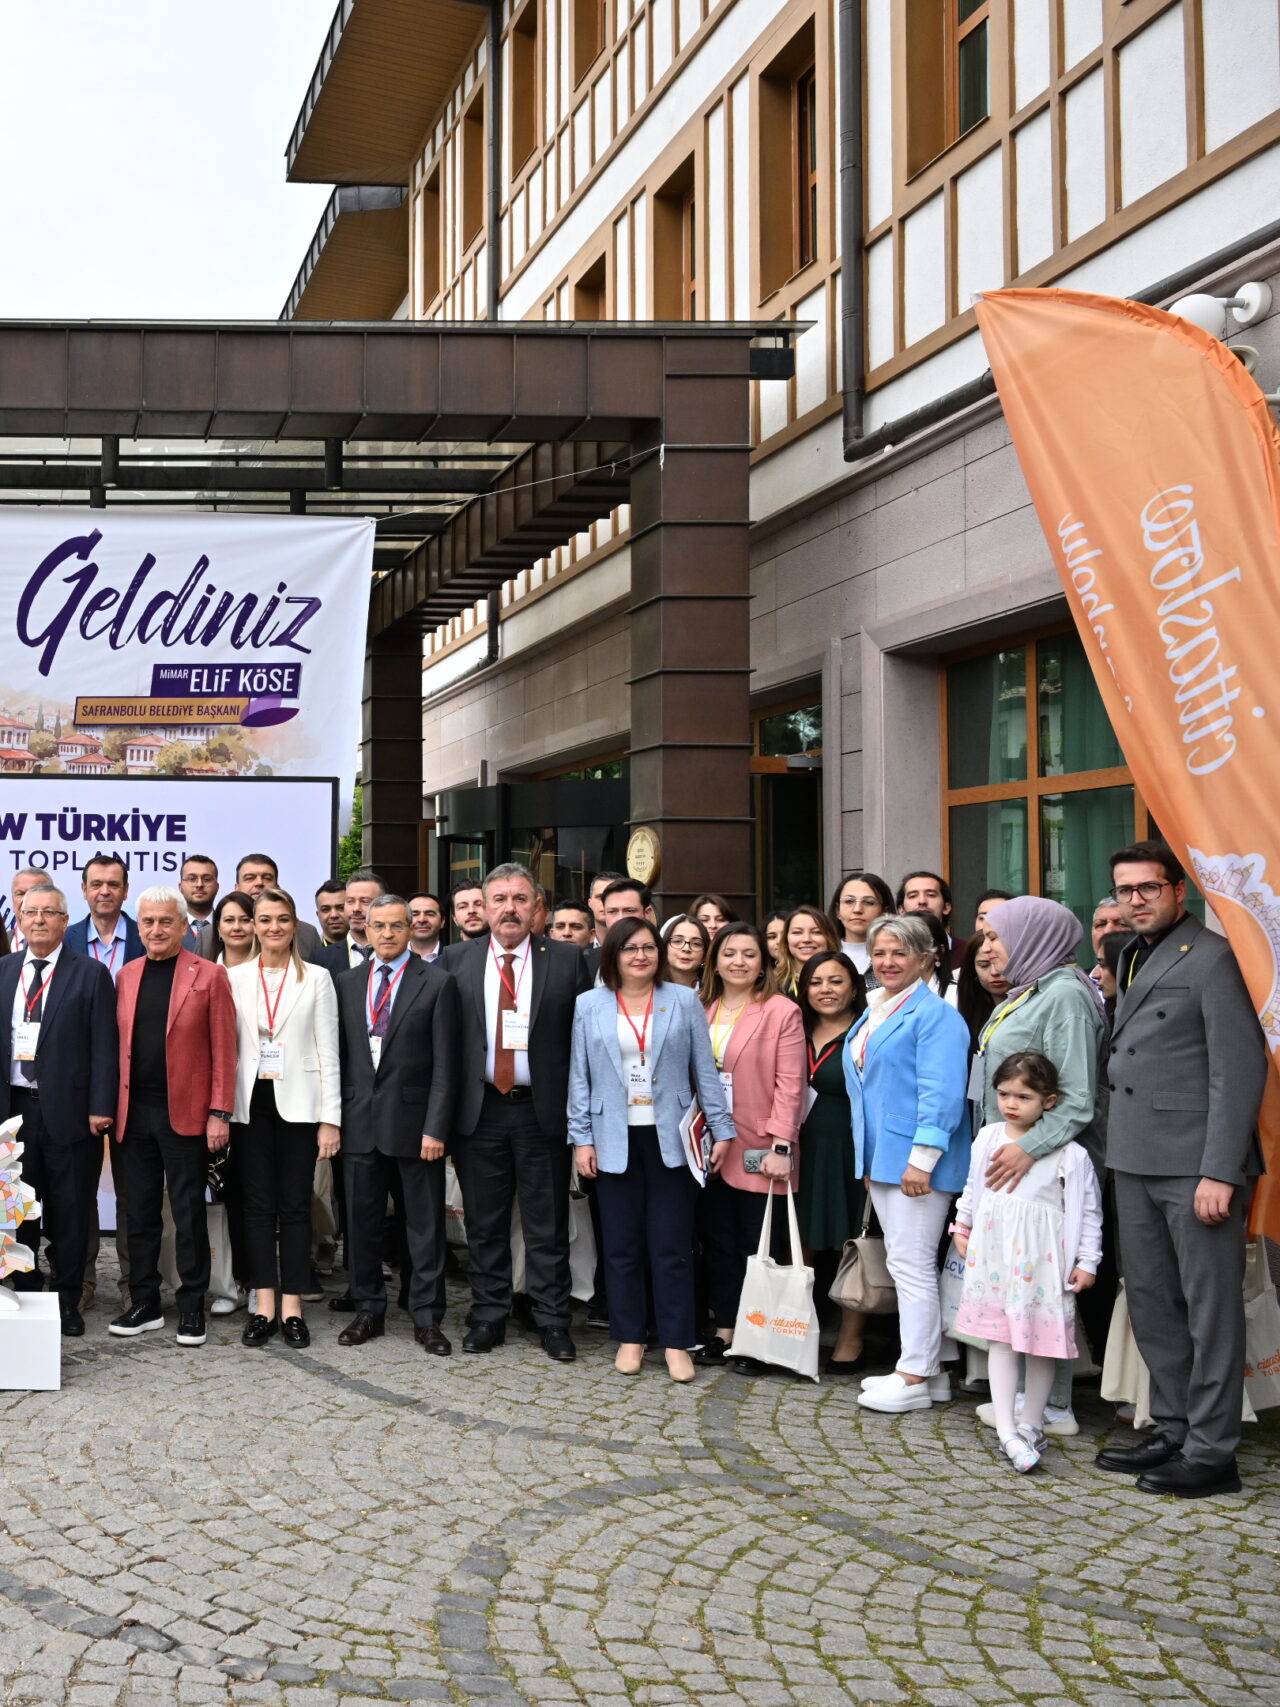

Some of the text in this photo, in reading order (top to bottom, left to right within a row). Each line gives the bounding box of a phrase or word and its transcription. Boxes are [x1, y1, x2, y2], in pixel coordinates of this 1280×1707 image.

[16, 528, 323, 677] Geldiniz
[238, 668, 295, 692] KÖSE
[81, 705, 147, 717] SAFRANBOLU
[196, 704, 240, 719] BAŞKANI
[35, 807, 187, 842] TÜRKİYE
[9, 849, 187, 872] TOPLNTIS
